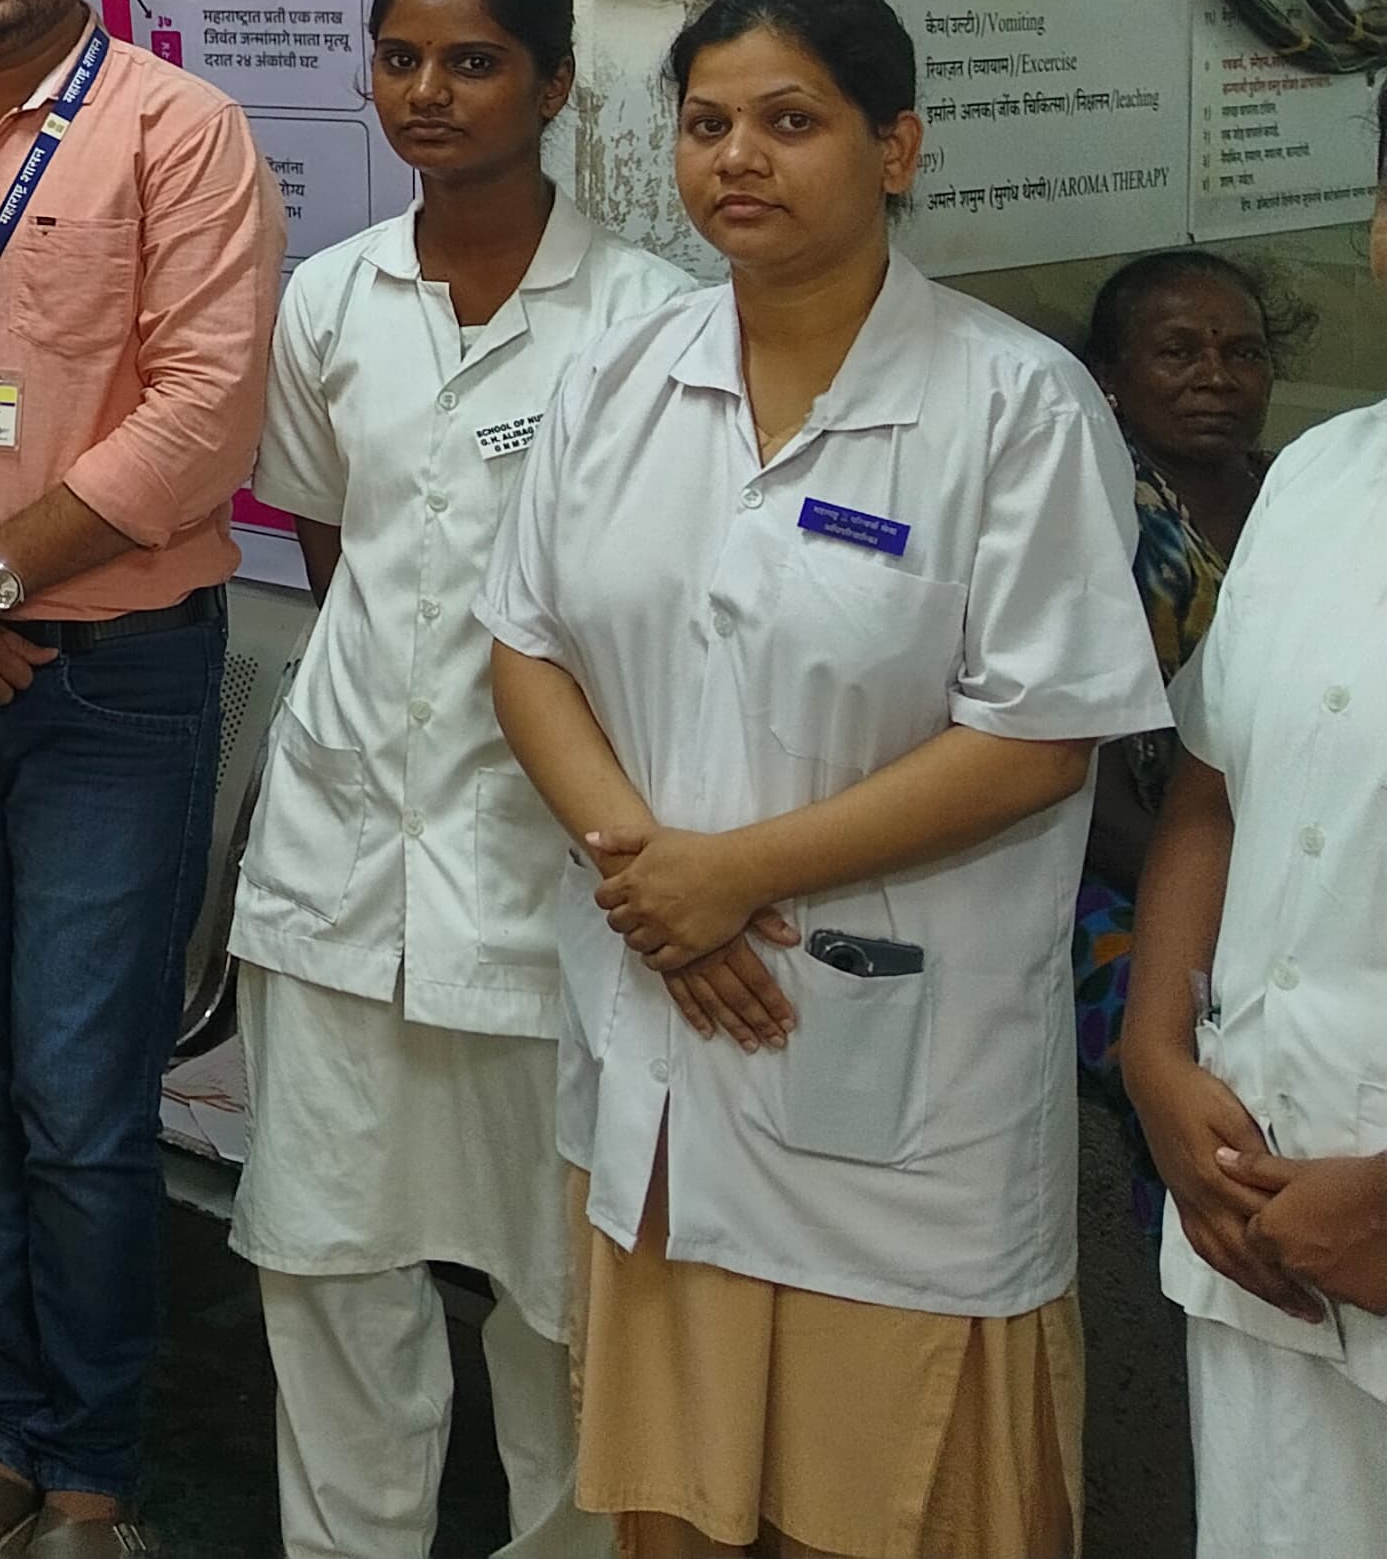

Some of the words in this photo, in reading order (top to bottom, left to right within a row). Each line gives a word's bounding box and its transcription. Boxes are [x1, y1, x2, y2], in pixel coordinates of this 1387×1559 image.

[289, 11, 310, 24] एक
[1112, 166, 1170, 192] THERAPY
[477, 422, 512, 438] SCHOOL
[513, 419, 526, 428] OF
[502, 427, 534, 442] ALIBAG
